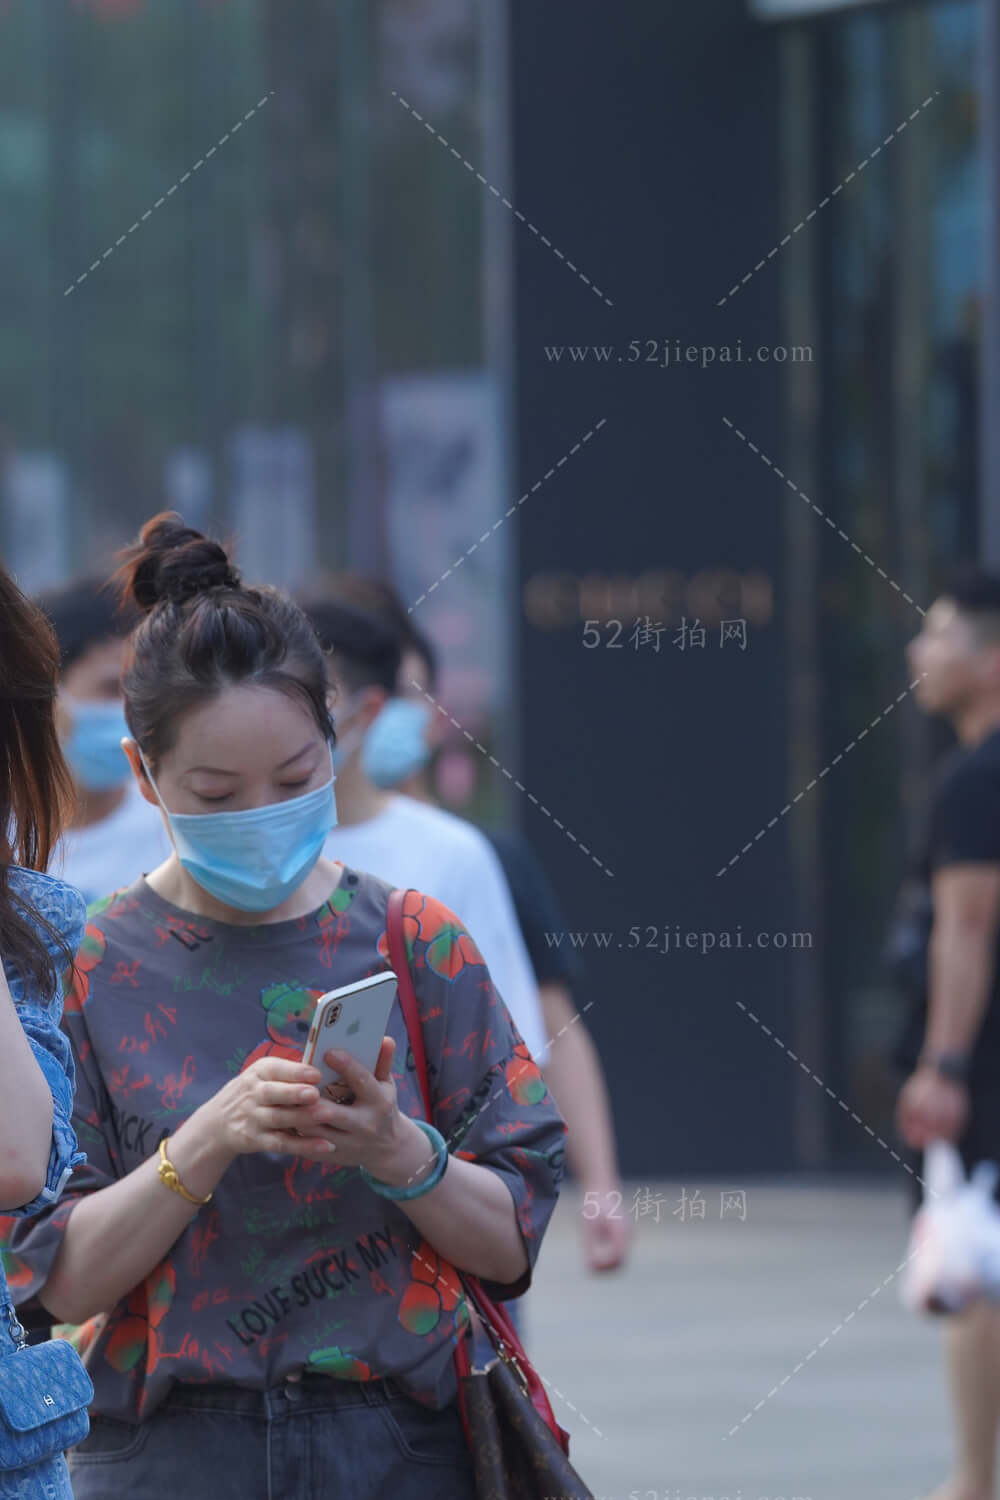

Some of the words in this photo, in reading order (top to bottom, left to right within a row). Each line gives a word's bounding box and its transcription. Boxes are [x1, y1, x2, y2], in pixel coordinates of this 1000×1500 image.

[225, 1286, 292, 1347] LOVE
[291, 1249, 360, 1307] SUCK
[354, 1226, 398, 1272] MY
